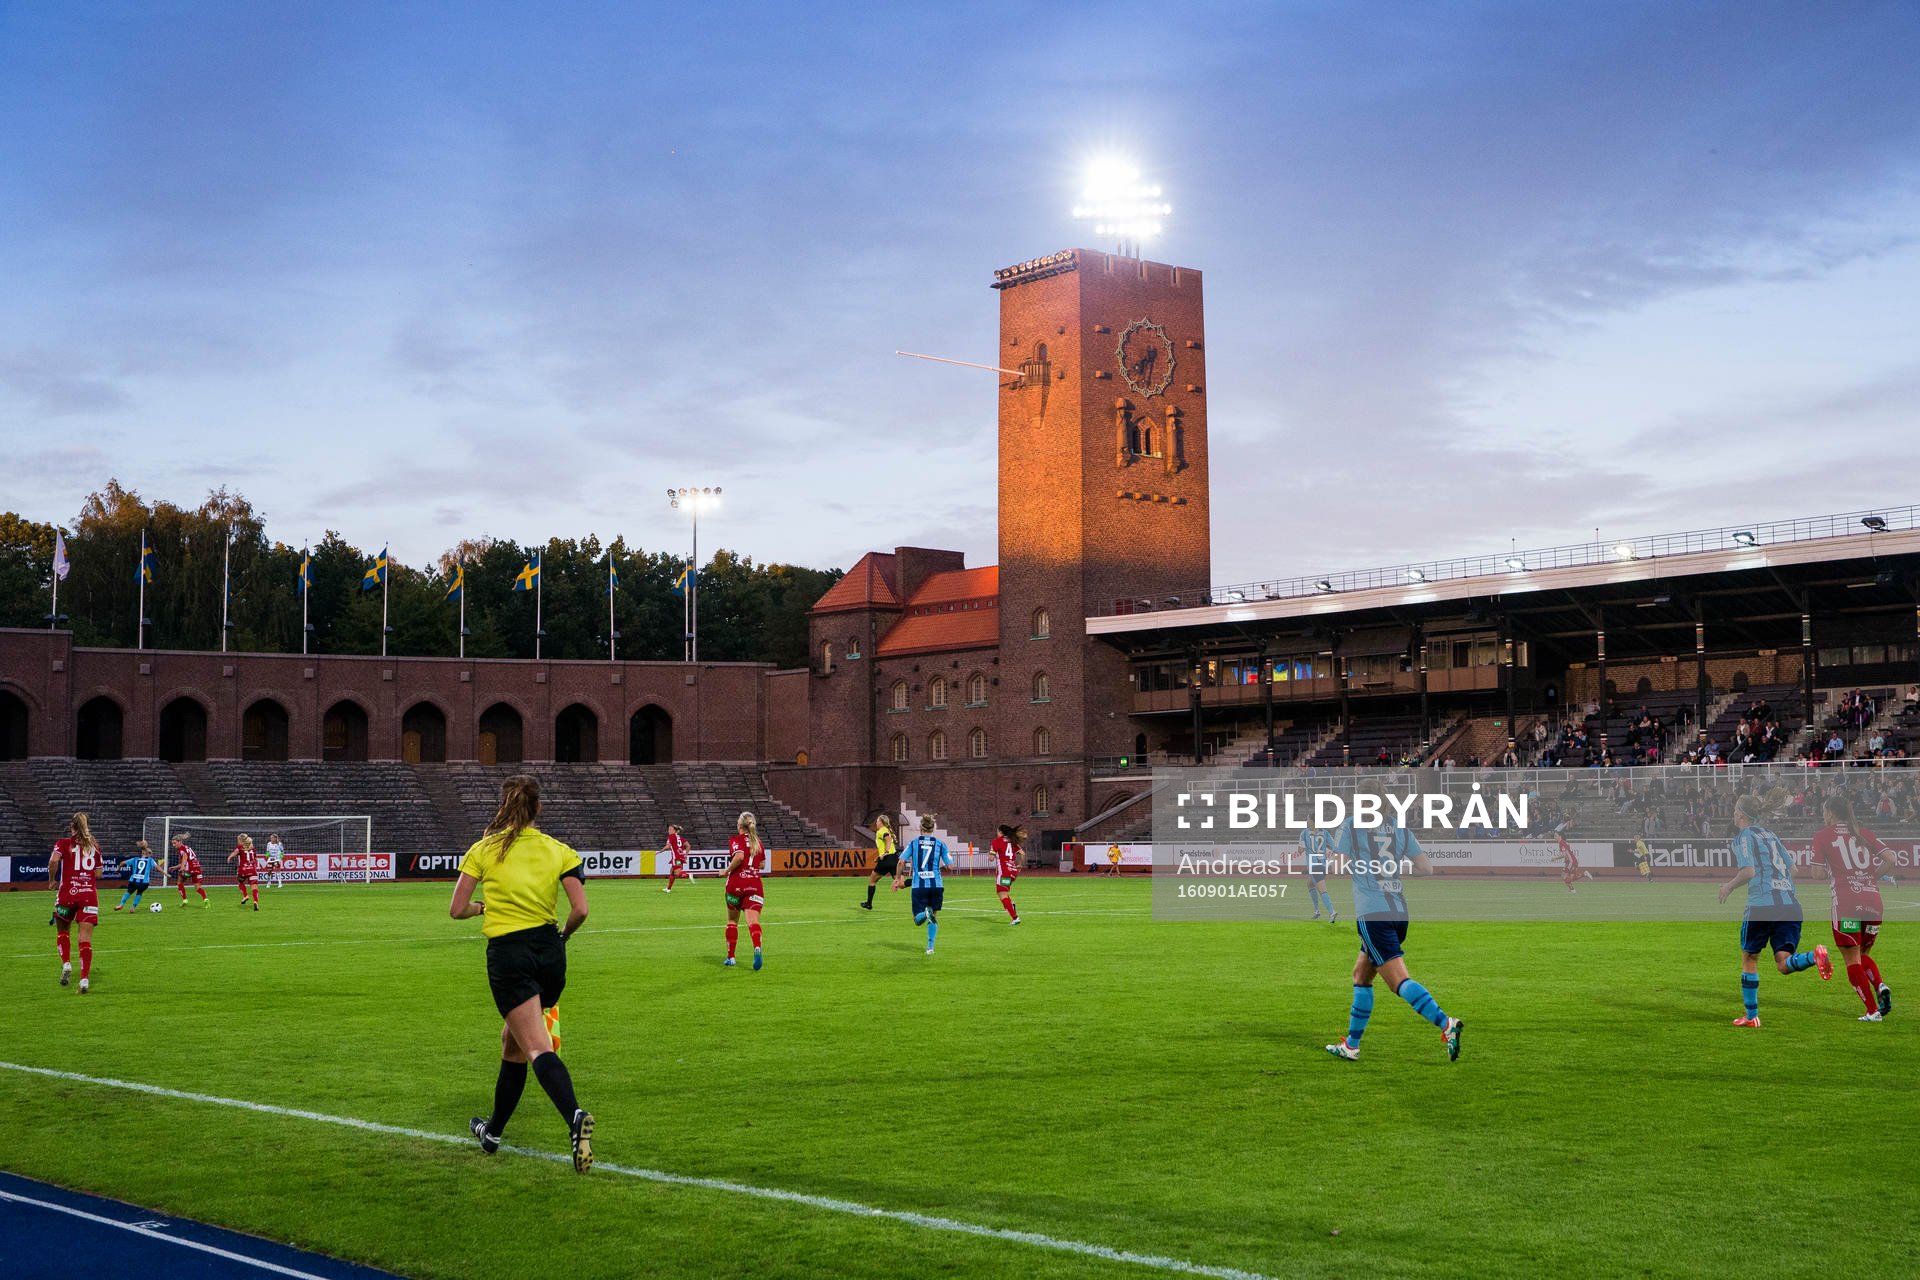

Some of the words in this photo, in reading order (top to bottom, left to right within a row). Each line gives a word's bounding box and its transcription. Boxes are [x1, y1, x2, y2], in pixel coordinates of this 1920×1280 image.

[1006, 842, 1013, 860] 4
[1309, 835, 1325, 853] 12
[1832, 835, 1871, 870] 16
[72, 844, 96, 871] 18
[330, 856, 389, 869] Miele
[582, 852, 633, 870] eber
[784, 851, 867, 870] JOBMAN
[921, 845, 933, 869] 7
[1373, 836, 1395, 878] 3
[1636, 843, 1732, 867] tadium
[1771, 840, 1787, 878] 4
[137, 860, 147, 874] 9
